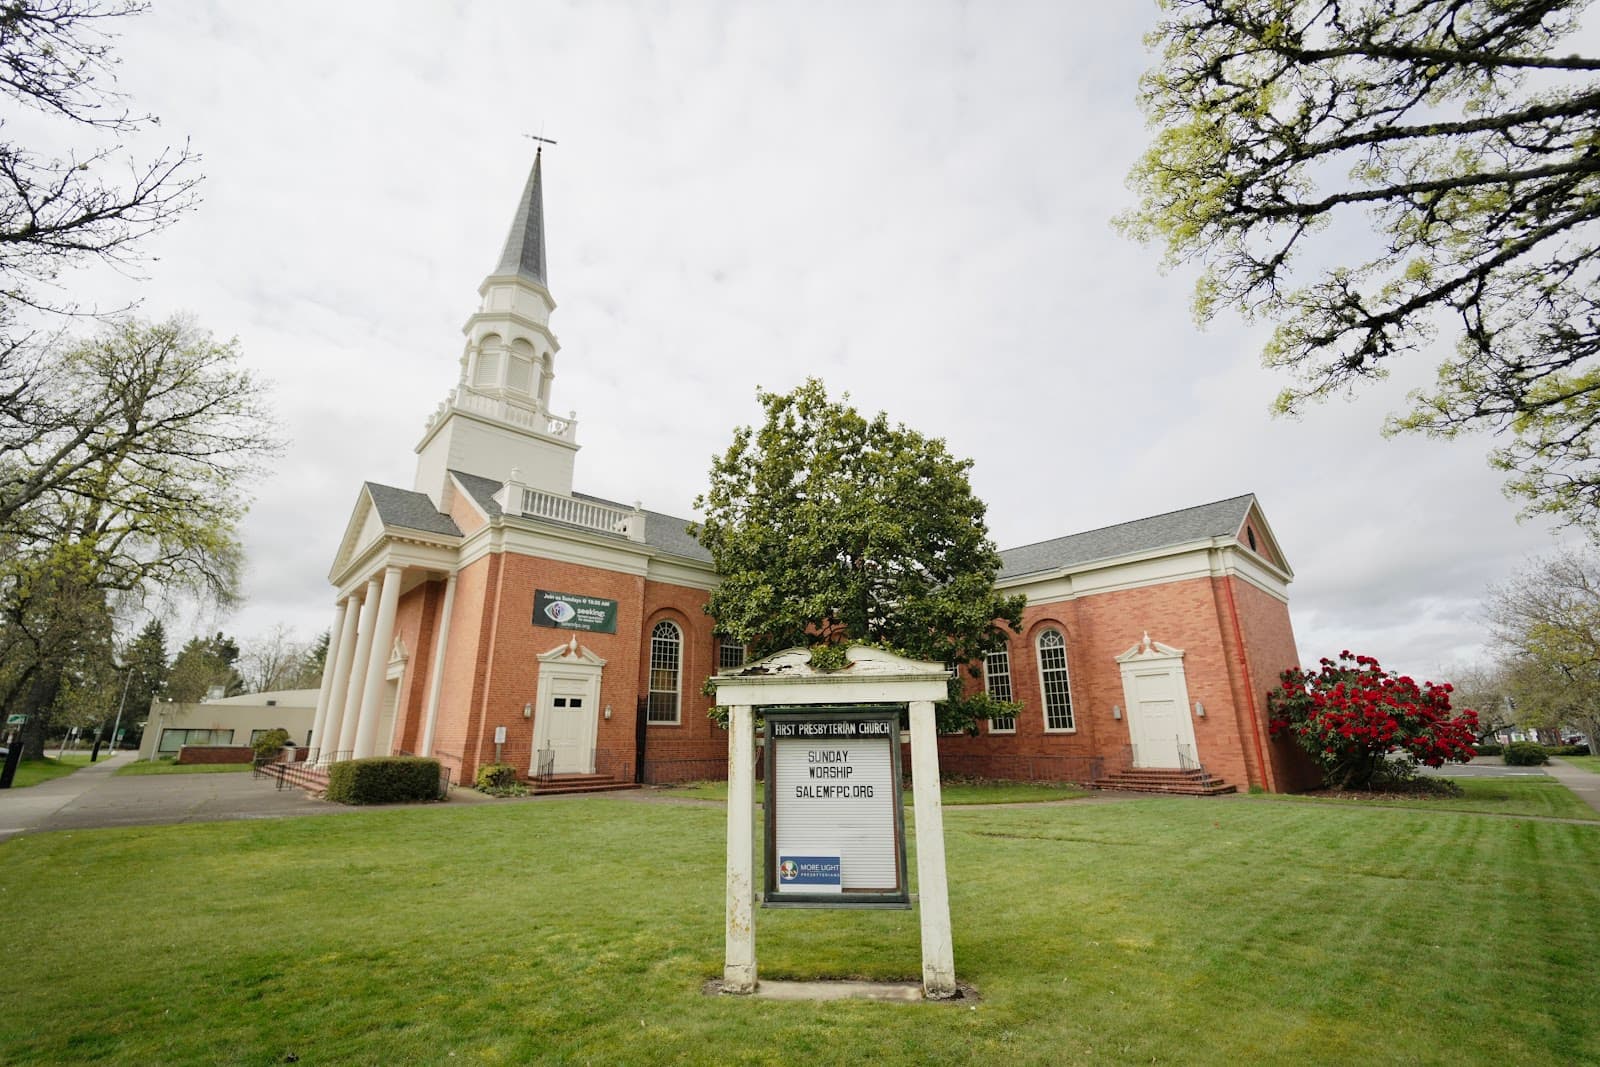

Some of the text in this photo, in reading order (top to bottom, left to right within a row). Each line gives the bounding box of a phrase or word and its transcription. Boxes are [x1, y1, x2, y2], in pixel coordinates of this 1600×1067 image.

[544, 592, 555, 600] Join
[562, 595, 582, 604] Sundays
[775, 722, 890, 736] FIRST PRESBYTERIAN CHURCH
[808, 750, 849, 763] SUNDAY
[809, 766, 853, 778] WORSHIP
[796, 785, 874, 798] SALEMFPC.ORG
